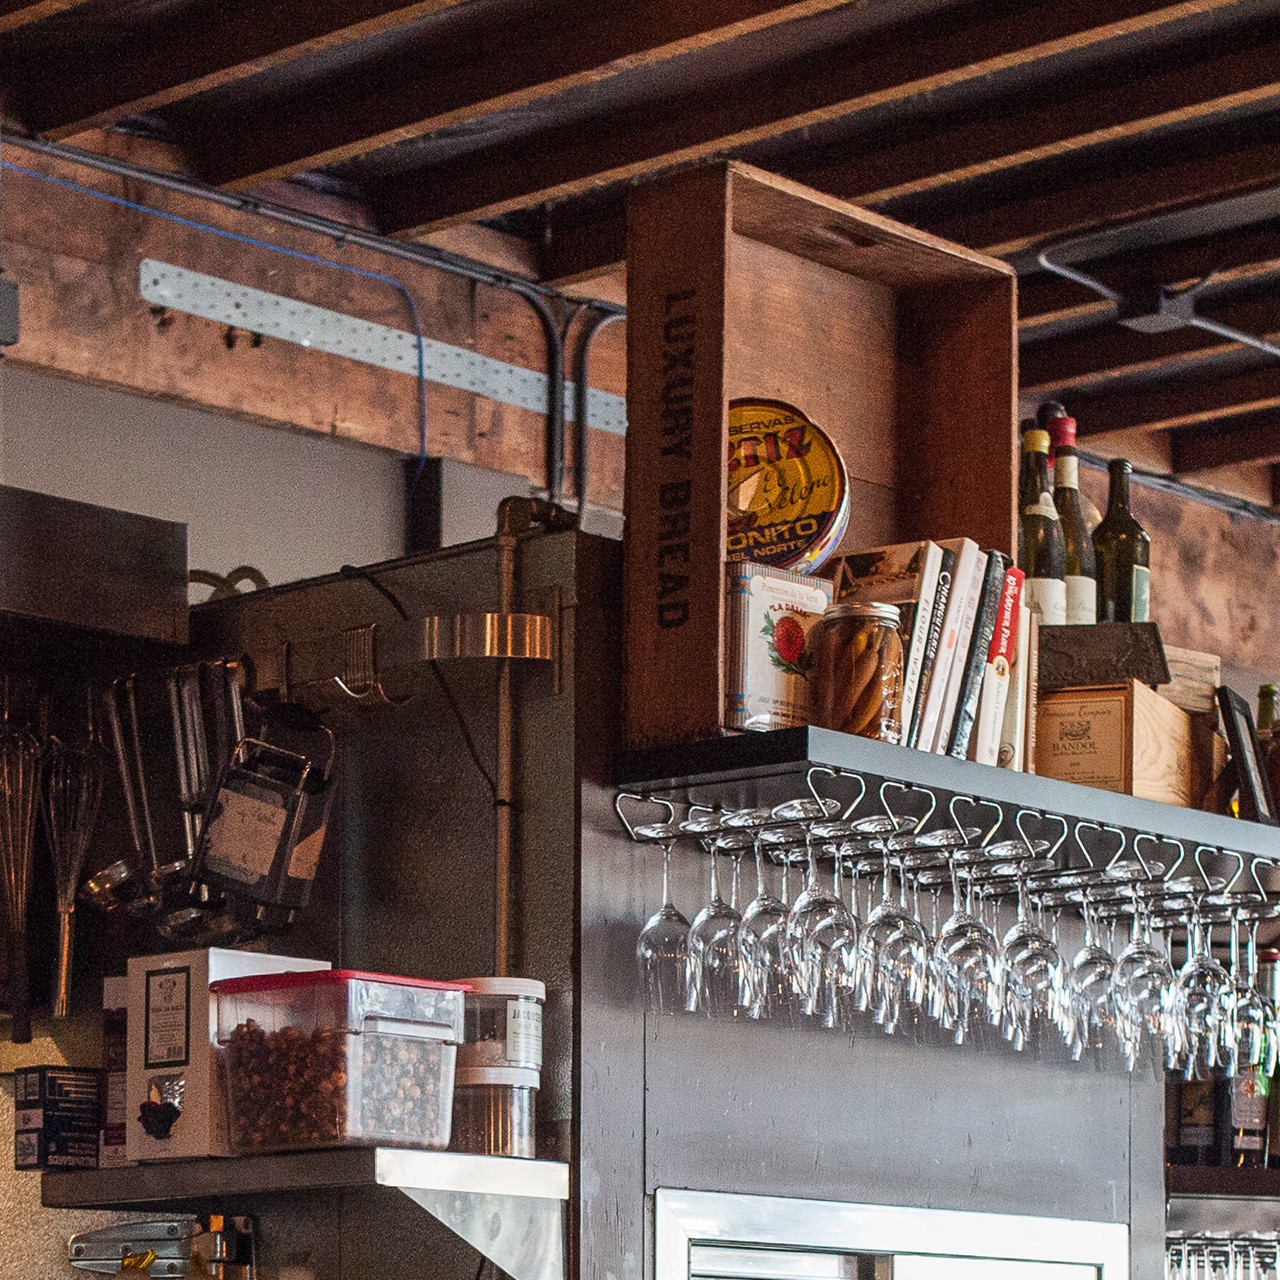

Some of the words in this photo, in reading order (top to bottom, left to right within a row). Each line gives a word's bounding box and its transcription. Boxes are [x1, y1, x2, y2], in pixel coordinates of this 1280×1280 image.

[660, 289, 697, 459] LUXURY
[657, 479, 692, 630] BREAD
[753, 538, 807, 557] NORTE
[917, 599, 929, 643] FLOUR
[998, 628, 1010, 654] FLOUR
[906, 657, 919, 704] WATER
[1053, 741, 1098, 752] BANDOL
